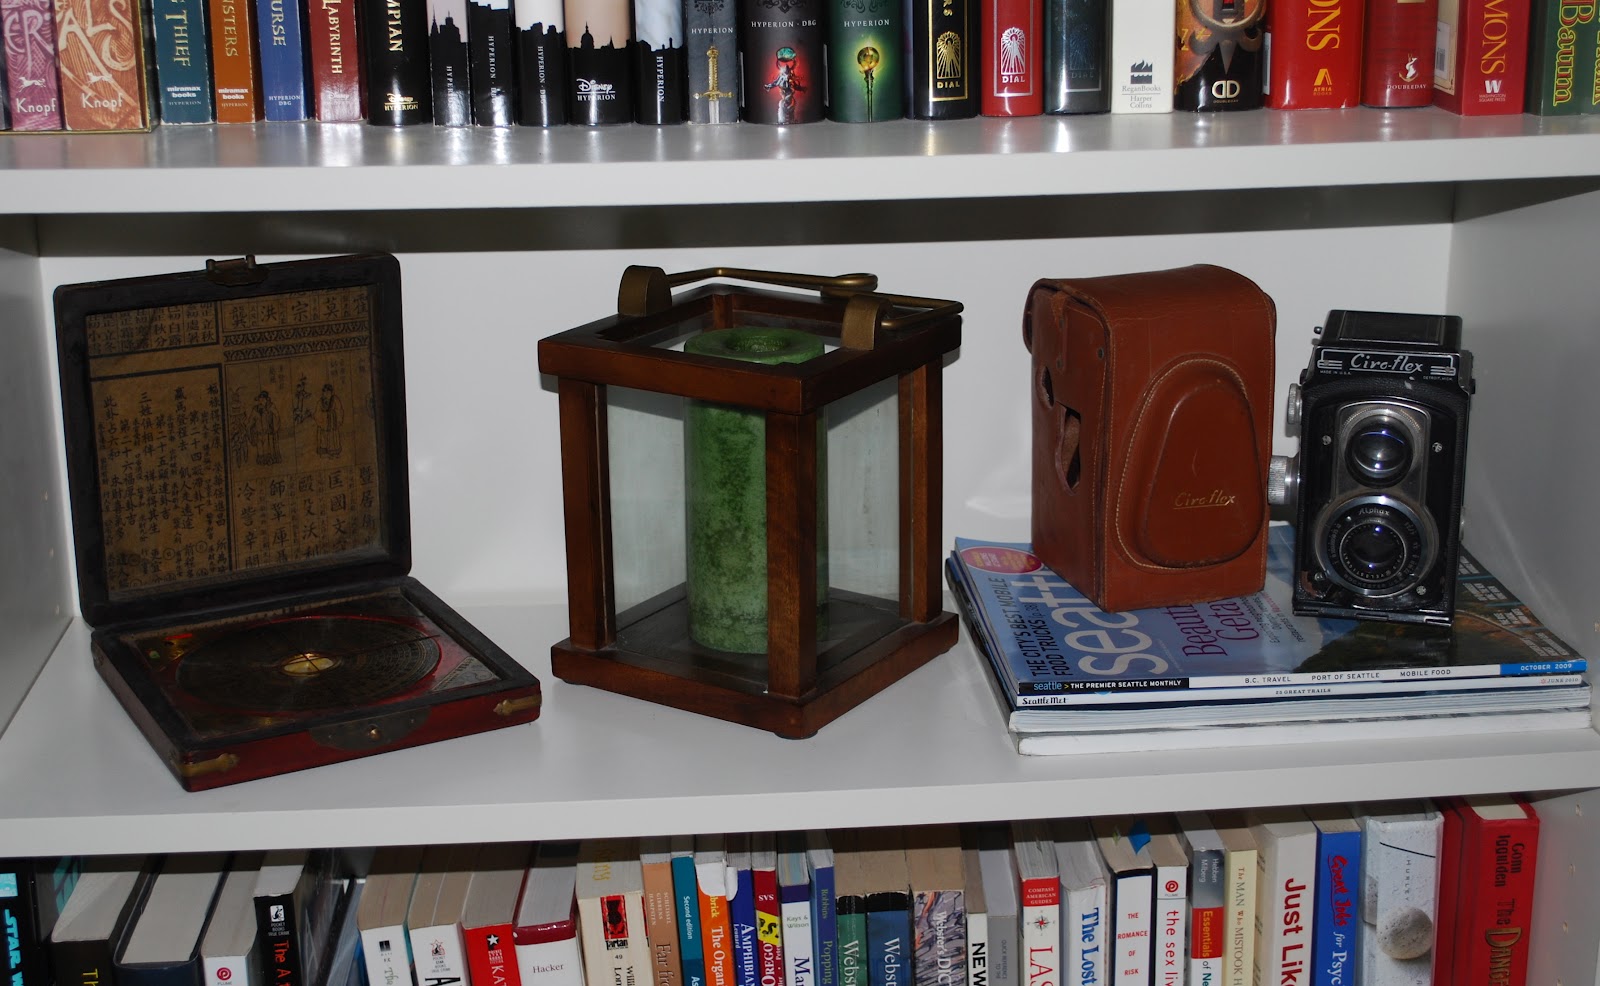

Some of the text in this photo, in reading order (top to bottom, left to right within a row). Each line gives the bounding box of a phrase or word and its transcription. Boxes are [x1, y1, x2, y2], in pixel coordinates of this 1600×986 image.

[844, 19, 890, 28] HYPERION
[165, 9, 191, 67] THIEF
[321, 0, 343, 74] LABYRINTH
[487, 35, 497, 79] HYPERION
[537, 45, 546, 84] HYPERION
[1553, 0, 1596, 106] Baum
[576, 78, 613, 93] Disney
[656, 56, 665, 102] HYPERION
[936, 81, 961, 89] DIAL
[1002, 75, 1026, 83] DIAL
[16, 98, 56, 116] Knopf
[81, 92, 123, 112] Knopf
[1130, 95, 1153, 104] Harper
[1130, 101, 1153, 109] Collins
[1350, 352, 1423, 372] Ciro-flex
[988, 577, 1050, 677] THE CITY'S BEST MOBILE
[1028, 619, 1074, 676] FOOD TRUCKS
[1034, 680, 1062, 691] seattle
[1070, 682, 1084, 690] THE
[1086, 681, 1116, 689] PREMIER
[1118, 680, 1148, 688] SEATTLE
[1150, 679, 1182, 687] MONTHLY
[1262, 675, 1292, 683] TRAVEL
[1347, 672, 1380, 680] SEATTLE
[1494, 834, 1511, 887] Iggulden
[1511, 842, 1525, 874] Conn
[683, 895, 692, 918] Second
[821, 889, 829, 919] Robbins
[1236, 881, 1246, 907] MAN
[1282, 878, 1306, 936] Just
[1166, 910, 1180, 936] the
[1236, 910, 1244, 926] Who
[1496, 898, 1516, 925] The
[4, 908, 22, 969] STAR
[712, 926, 724, 948] The
[933, 911, 948, 956] Webster's
[1081, 907, 1100, 986] The Lost
[1117, 930, 1148, 940] ROMANCE
[1202, 910, 1214, 957] Essentials
[1333, 931, 1346, 948] for
[273, 940, 290, 963] The
[656, 943, 672, 968] Far
[821, 941, 833, 985] Popping
[971, 942, 988, 986] NEW
[1165, 942, 1176, 966] sex
[1202, 960, 1212, 969] of
[1233, 928, 1244, 975] MISTOOK
[532, 964, 564, 974] Hacker
[1124, 968, 1139, 976] RISK
